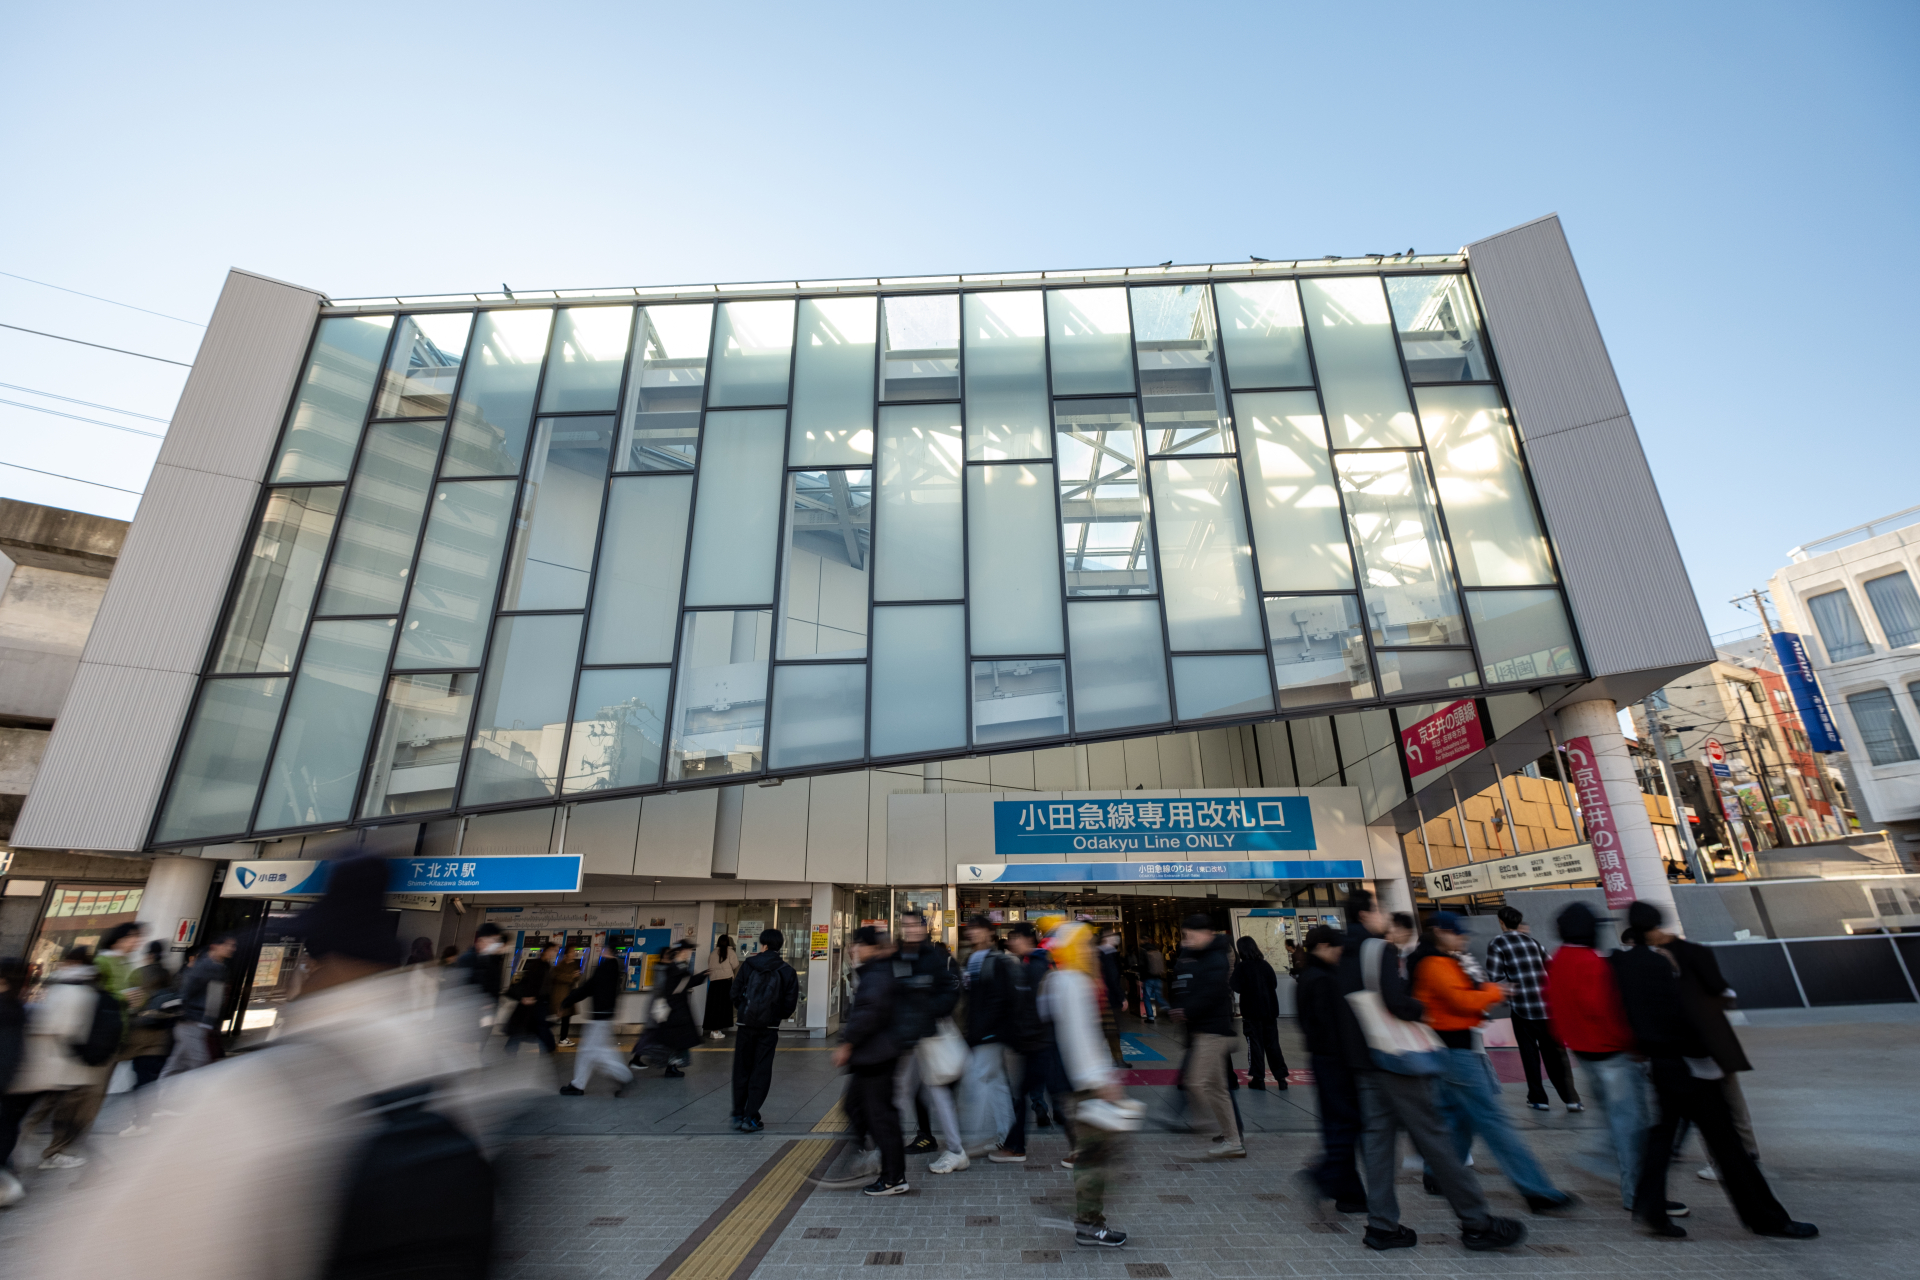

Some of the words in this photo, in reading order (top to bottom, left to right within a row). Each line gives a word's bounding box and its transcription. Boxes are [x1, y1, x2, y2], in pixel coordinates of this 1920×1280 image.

[1418, 701, 1476, 744] 京王井の頭線
[1019, 800, 1286, 831] 小田急線専用改札口
[1575, 767, 1628, 892] 京王井の頭線
[1073, 835, 1139, 853] Odakyu
[1145, 835, 1181, 849] Line
[1186, 834, 1236, 848] ONLY
[258, 873, 288, 882] 小田急
[411, 862, 477, 878] 下北沢駅
[1139, 864, 1193, 873] 小田急線のりば
